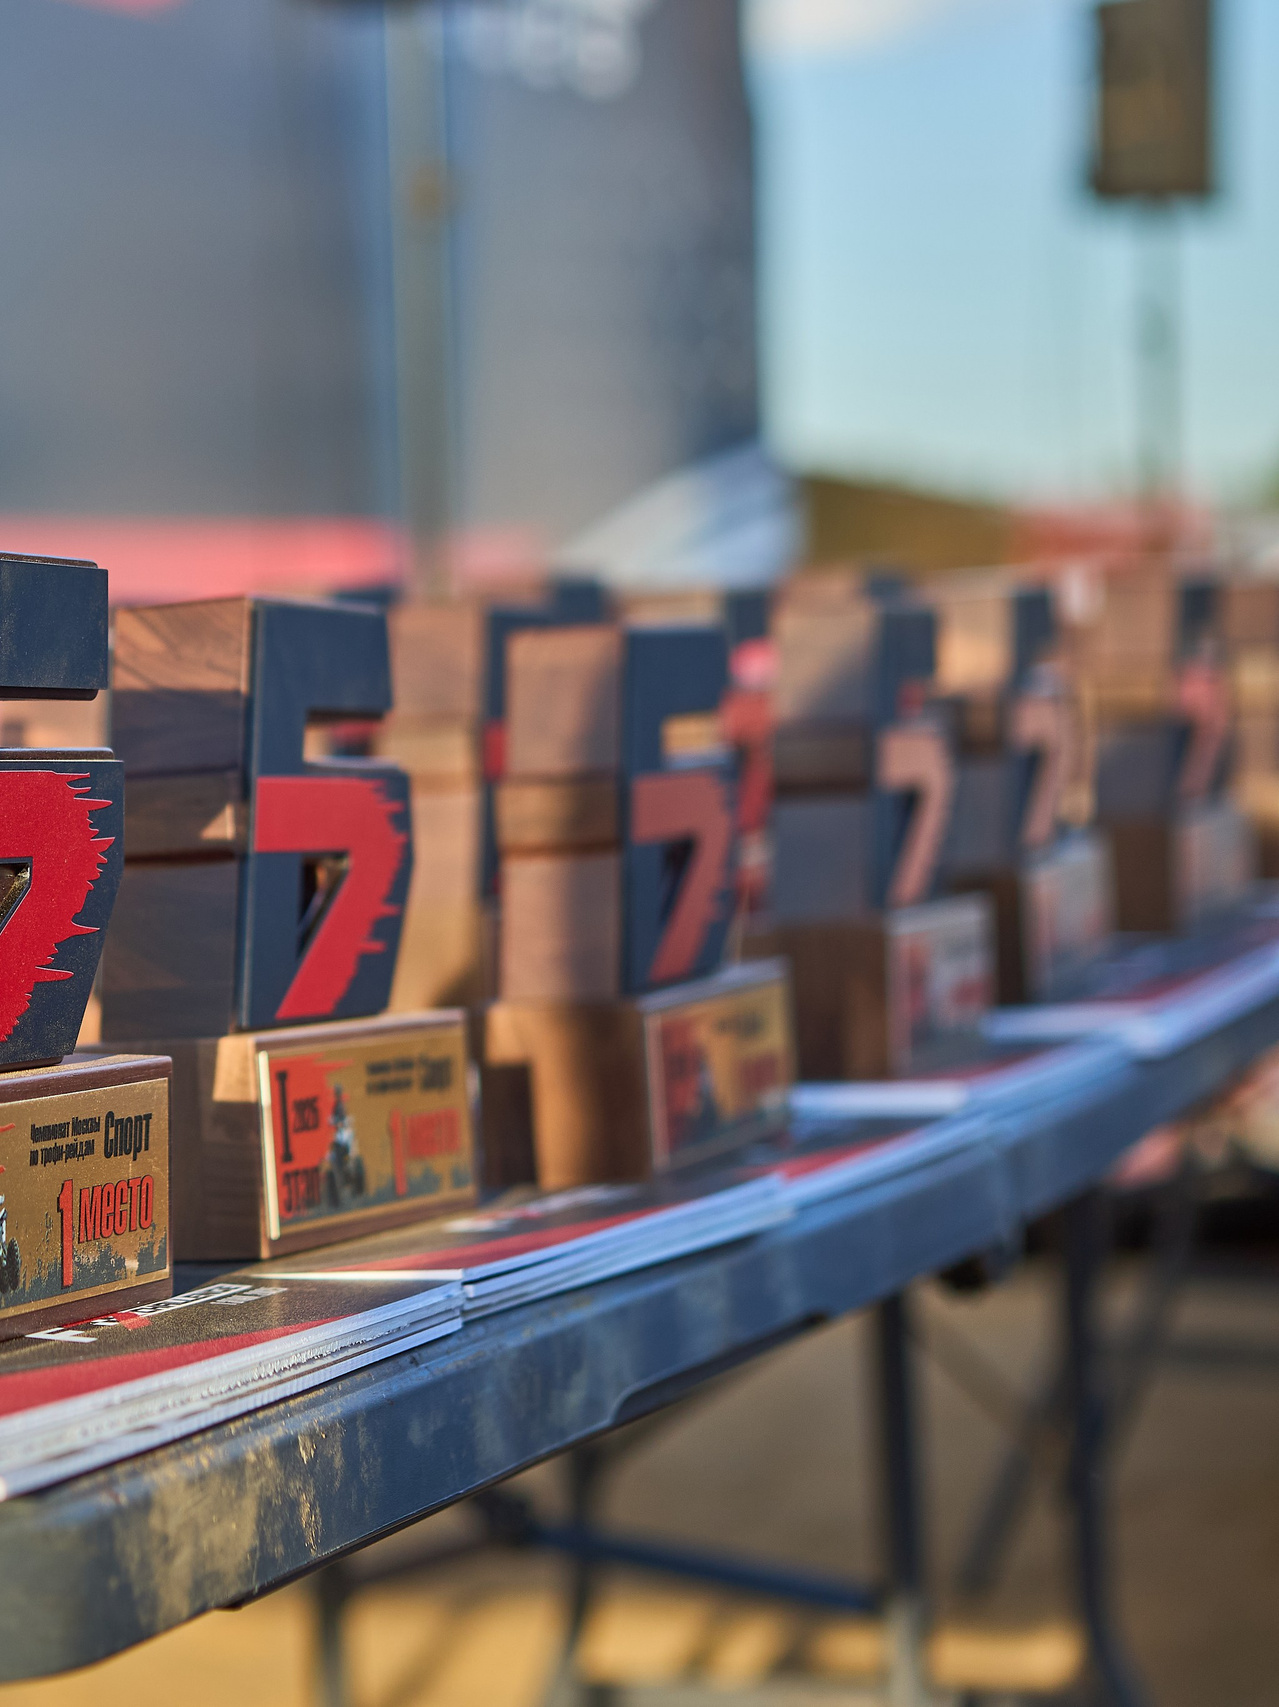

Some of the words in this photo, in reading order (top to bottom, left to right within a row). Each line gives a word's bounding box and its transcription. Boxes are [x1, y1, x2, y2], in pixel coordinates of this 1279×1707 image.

[103, 1110, 153, 1162] Спорт
[389, 1108, 408, 1196] 1
[57, 1178, 74, 1290] 1
[77, 1174, 155, 1245] место
